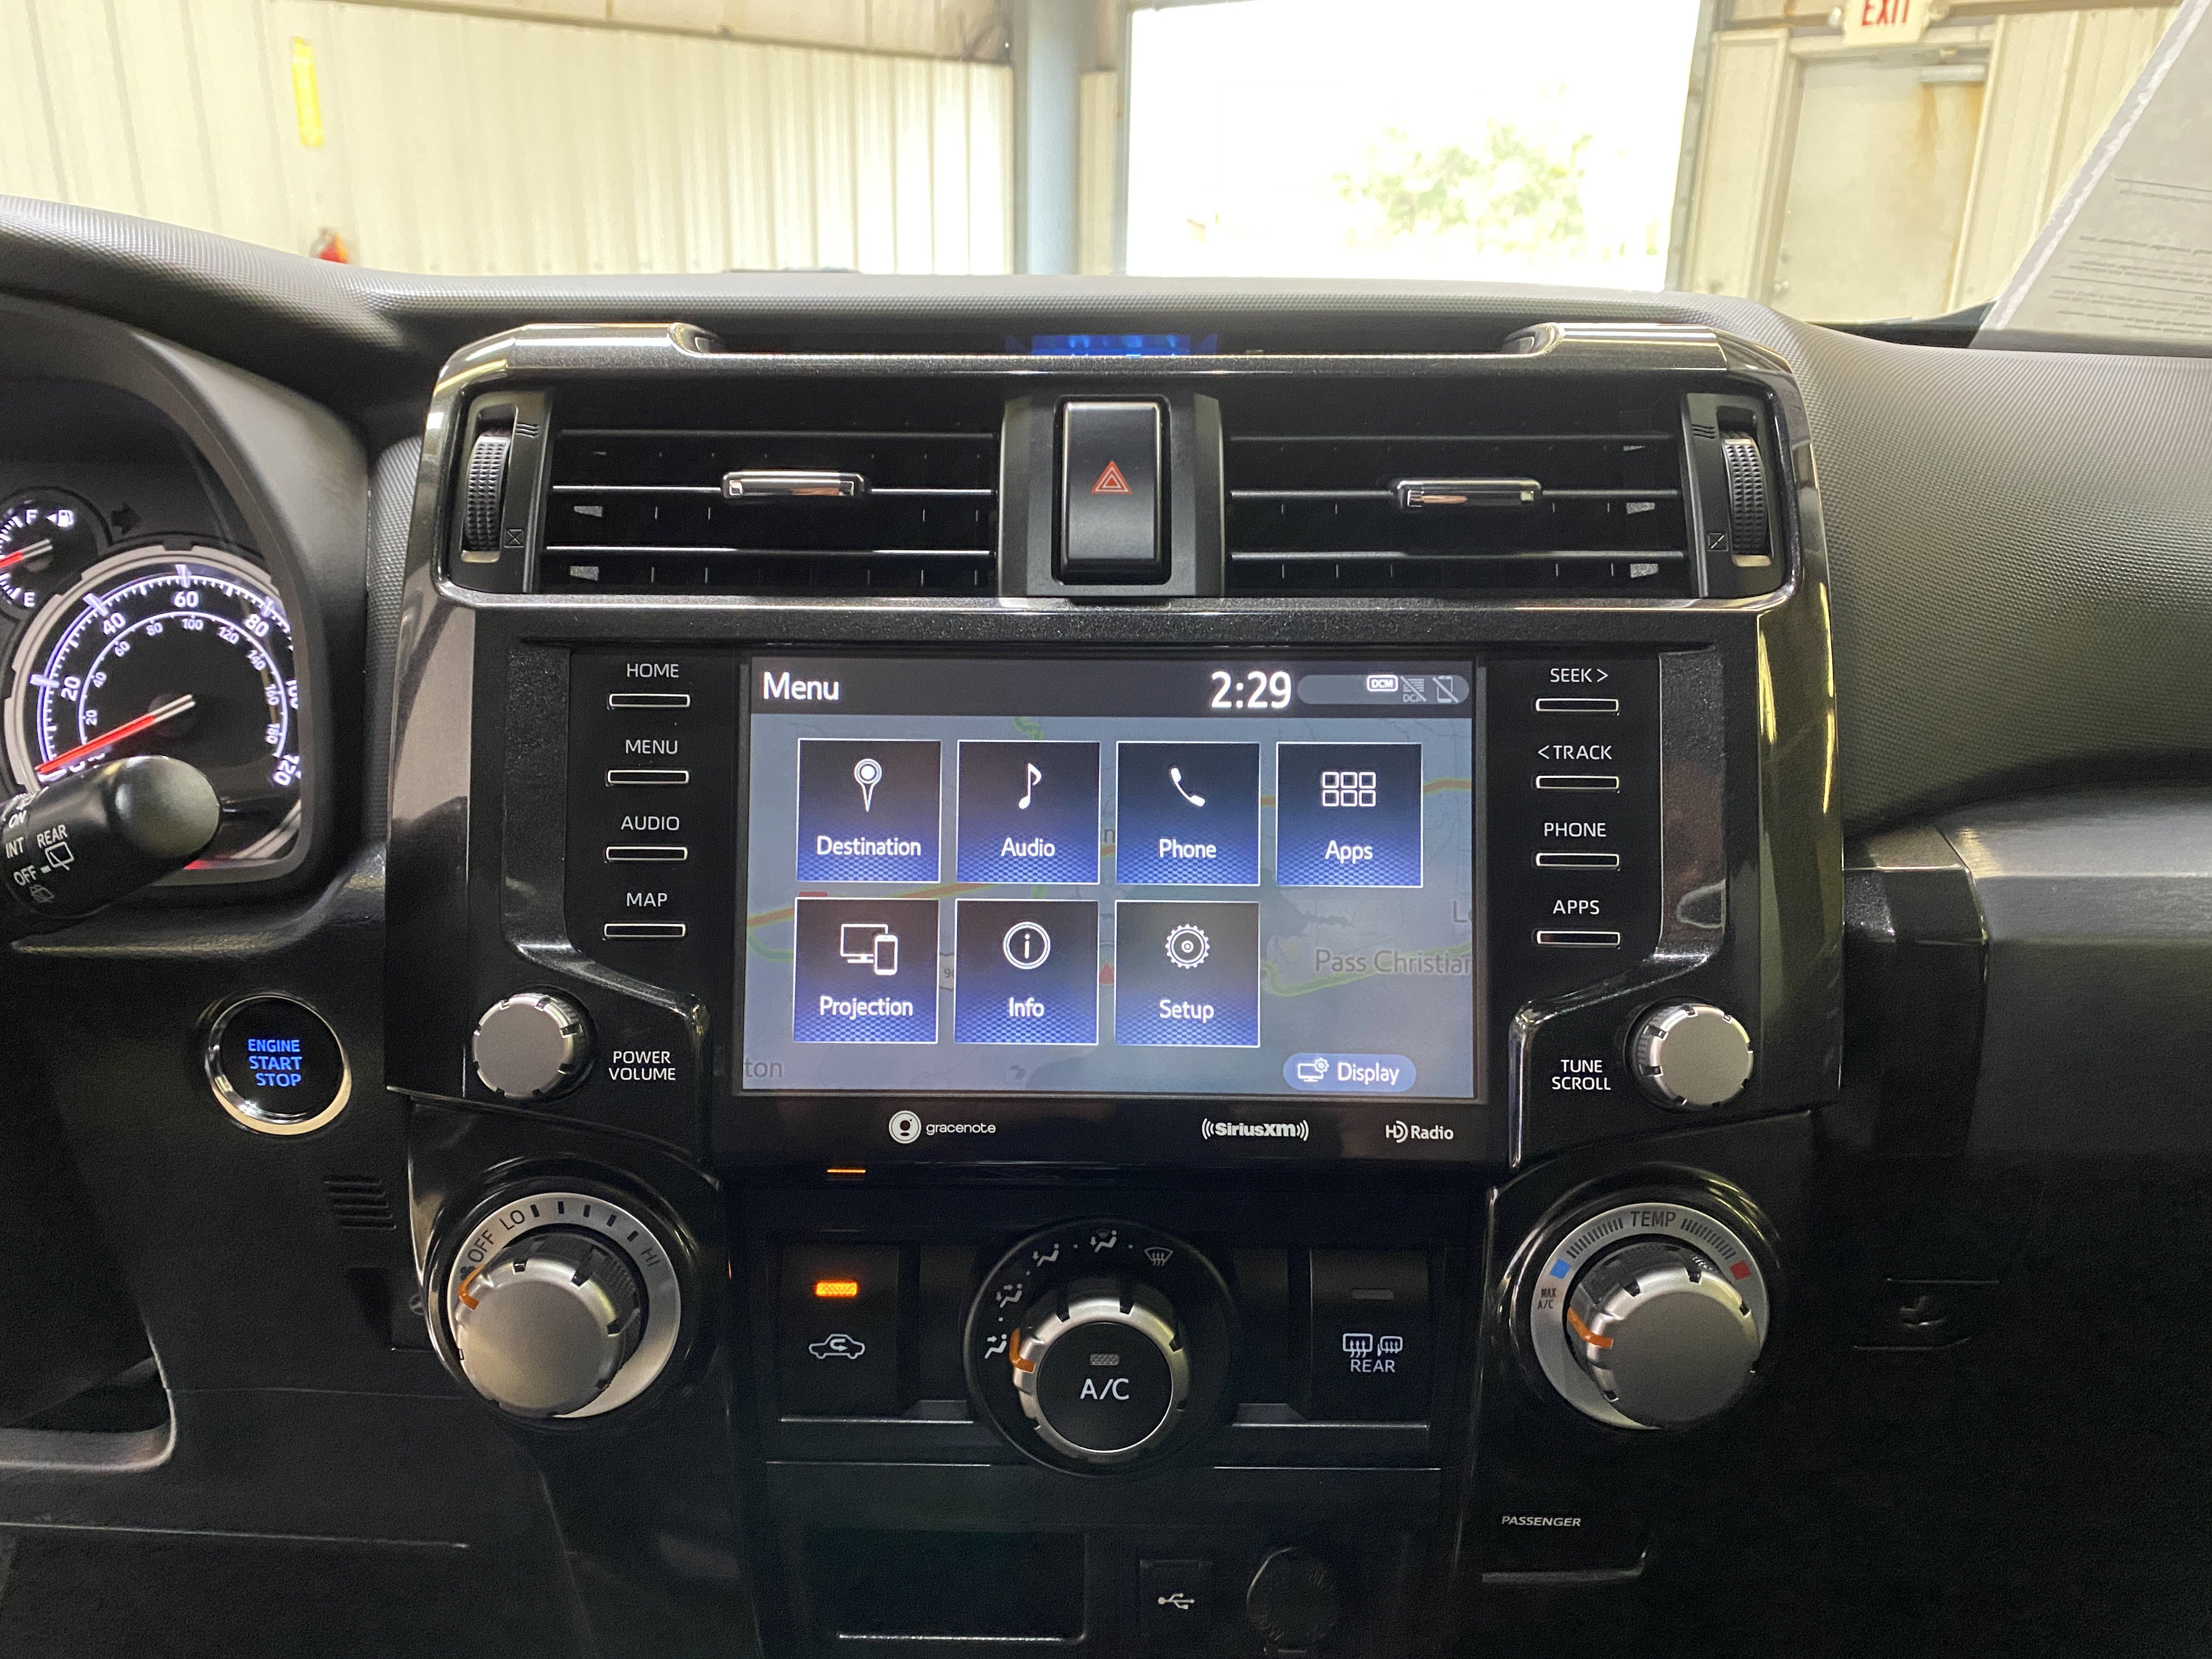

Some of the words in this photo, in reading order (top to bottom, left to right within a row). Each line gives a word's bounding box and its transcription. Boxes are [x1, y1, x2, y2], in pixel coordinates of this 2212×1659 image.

[26, 510, 38, 523] F
[24, 592, 35, 607] E
[174, 591, 199, 608] 60
[103, 612, 126, 635] 40
[146, 622, 163, 636] 80
[182, 618, 204, 631] 100
[245, 613, 269, 637] 80
[218, 627, 239, 644] 120
[114, 641, 131, 657] 60
[246, 650, 266, 671] 140
[626, 664, 679, 678] HOME
[60, 676, 81, 701] 20
[92, 672, 107, 688] 40
[763, 671, 840, 701] Menu
[265, 684, 280, 706] 160
[1210, 670, 1293, 708] 2:29
[85, 709, 98, 726] 20
[265, 723, 280, 744] 180
[625, 740, 679, 754] MENU
[274, 754, 300, 786] 120
[620, 816, 680, 831] AUDIO
[1544, 823, 1606, 838] PHONE
[36, 824, 67, 848] REAR
[5, 837, 24, 859] INT
[816, 836, 922, 856] Destination
[1001, 837, 1056, 857] Audio
[1159, 838, 1217, 859] Phone
[1324, 840, 1373, 864] Apps
[14, 865, 36, 886] OFF
[626, 893, 668, 907] MAP
[1553, 900, 1600, 915] APPS
[1316, 949, 1367, 973] Pass
[820, 996, 913, 1019] Projection
[1008, 997, 1045, 1018] Info
[1159, 999, 1215, 1023] Setup
[247, 1039, 300, 1052] ENGINE
[249, 1056, 302, 1070] START
[613, 1051, 671, 1064] POWER
[609, 1068, 676, 1081] VOLUME
[1337, 1063, 1400, 1085] Display
[1560, 1060, 1602, 1074] TUNE
[255, 1073, 302, 1087] STOP
[1551, 1077, 1611, 1091] SCROLL
[926, 1122, 996, 1136] gracenote
[1410, 1125, 1454, 1140] Radio
[498, 1209, 526, 1231] LO
[1630, 1211, 1677, 1227] TEMP
[467, 1229, 494, 1263] OFF
[641, 1247, 661, 1267] HI
[1541, 1287, 1557, 1298] MAX
[1537, 1299, 1554, 1310] A/C
[1350, 1359, 1396, 1373] REAR
[1080, 1379, 1130, 1401] A/C
[1501, 1515, 1582, 1527] PASSENGER
